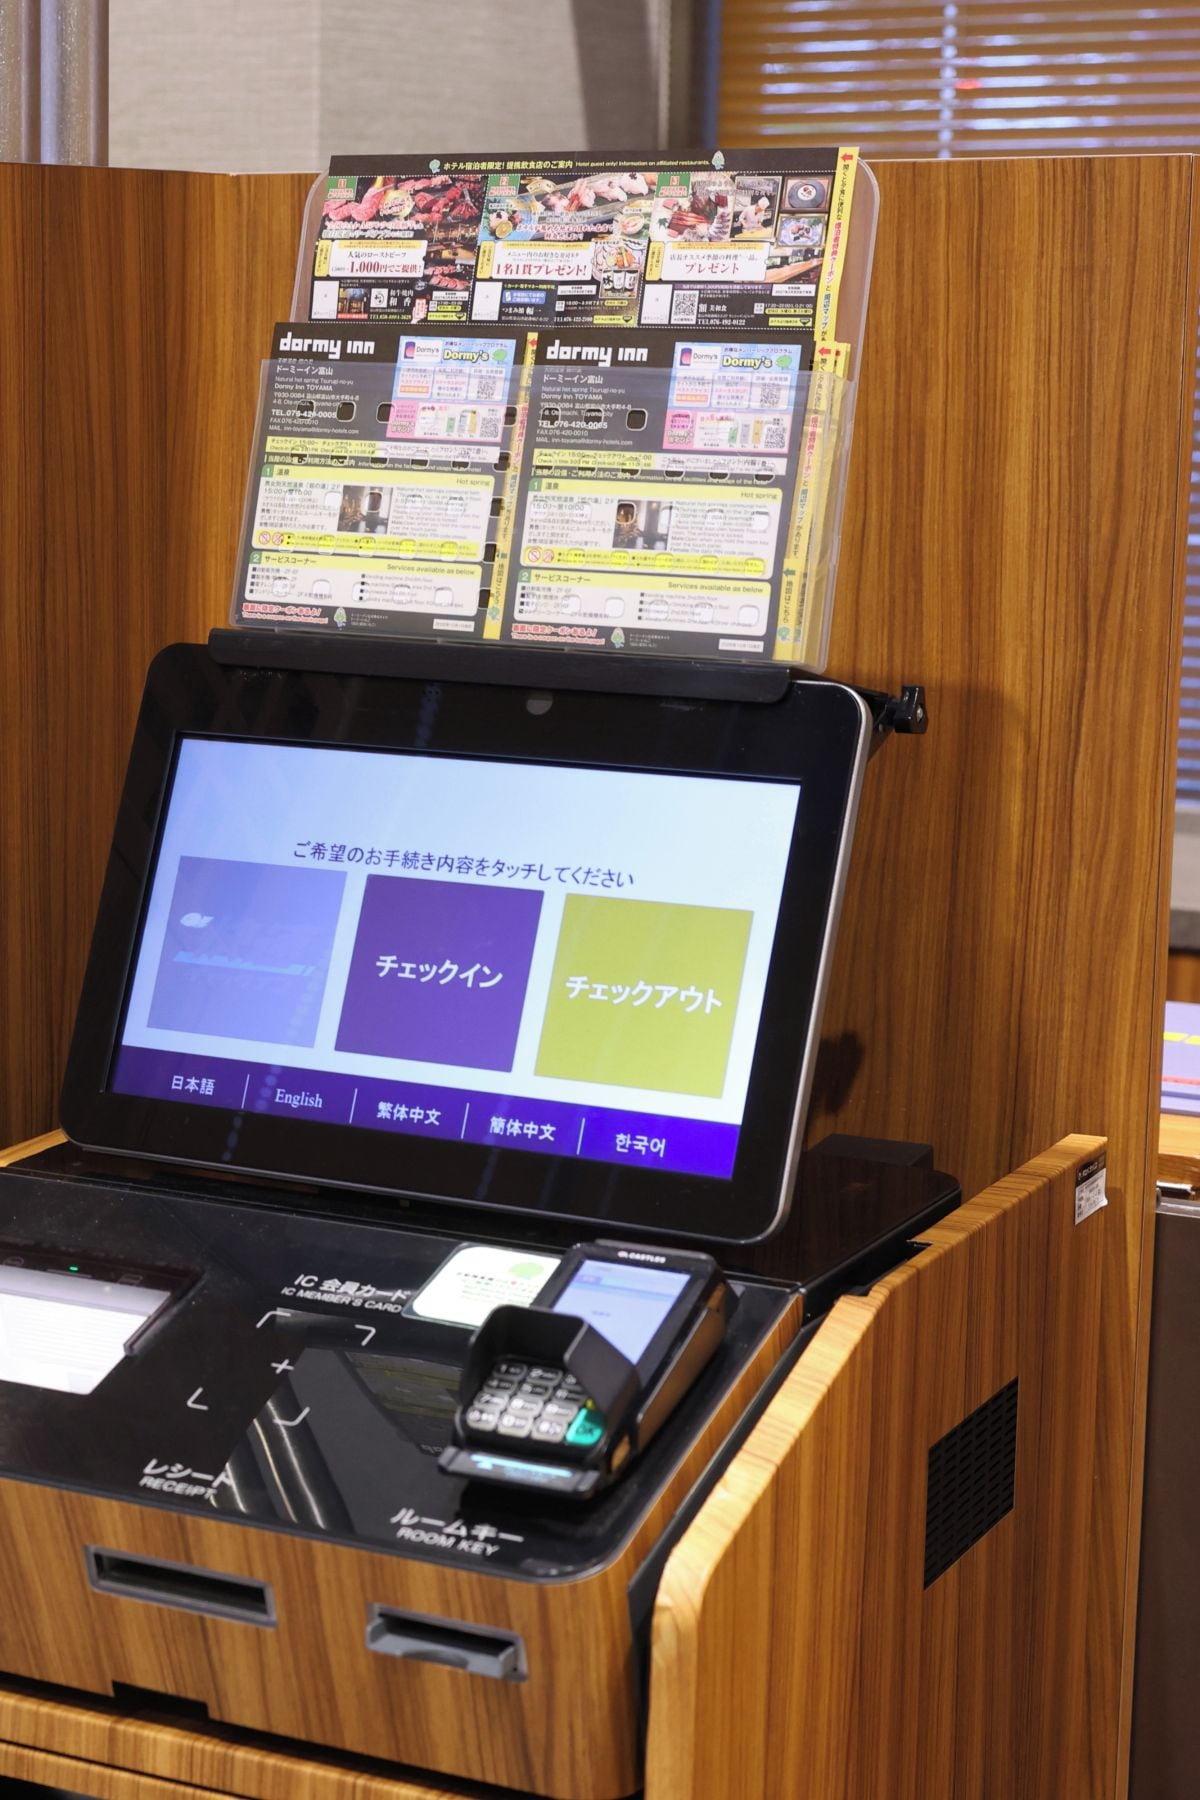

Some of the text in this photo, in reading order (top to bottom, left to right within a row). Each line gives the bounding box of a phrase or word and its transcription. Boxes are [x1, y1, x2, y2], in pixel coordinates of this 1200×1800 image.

[685, 261, 740, 275] プレゼント
[279, 332, 375, 360] dormy inn
[416, 346, 440, 354] Dormy's
[443, 348, 490, 363] Dormy's
[546, 339, 648, 368] dormy inn
[693, 352, 718, 360] Dormy's
[276, 364, 334, 376] ドーミーイン富山
[722, 354, 773, 369] Dormy's
[543, 374, 604, 384] ドーミーイン富山
[265, 555, 317, 564] サービスコーナー
[387, 563, 415, 571] Services
[416, 565, 445, 573] available
[455, 567, 476, 575] below
[534, 573, 591, 583] サービスコーナー
[668, 581, 698, 589] Services
[699, 583, 731, 592] available
[742, 585, 763, 593] below
[293, 841, 635, 888] ご希望のお手続き内容をタッチしてください
[375, 953, 504, 989] チェックイン
[565, 975, 723, 1014] チェックアウト
[170, 1075, 216, 1096] 日本語
[274, 1088, 324, 1109] English
[376, 1101, 441, 1126] 繁体中文
[489, 1116, 557, 1141] 簡体中文
[615, 1133, 667, 1158] 한국어
[280, 1286, 402, 1313] IC MEMBER'S CARD
[294, 1274, 412, 1302] IC 会員カード
[142, 1458, 233, 1489] レシート
[138, 1475, 218, 1500] RECEIPT
[389, 1507, 525, 1543] ルームキー
[396, 1526, 500, 1557] ROOM KEY
